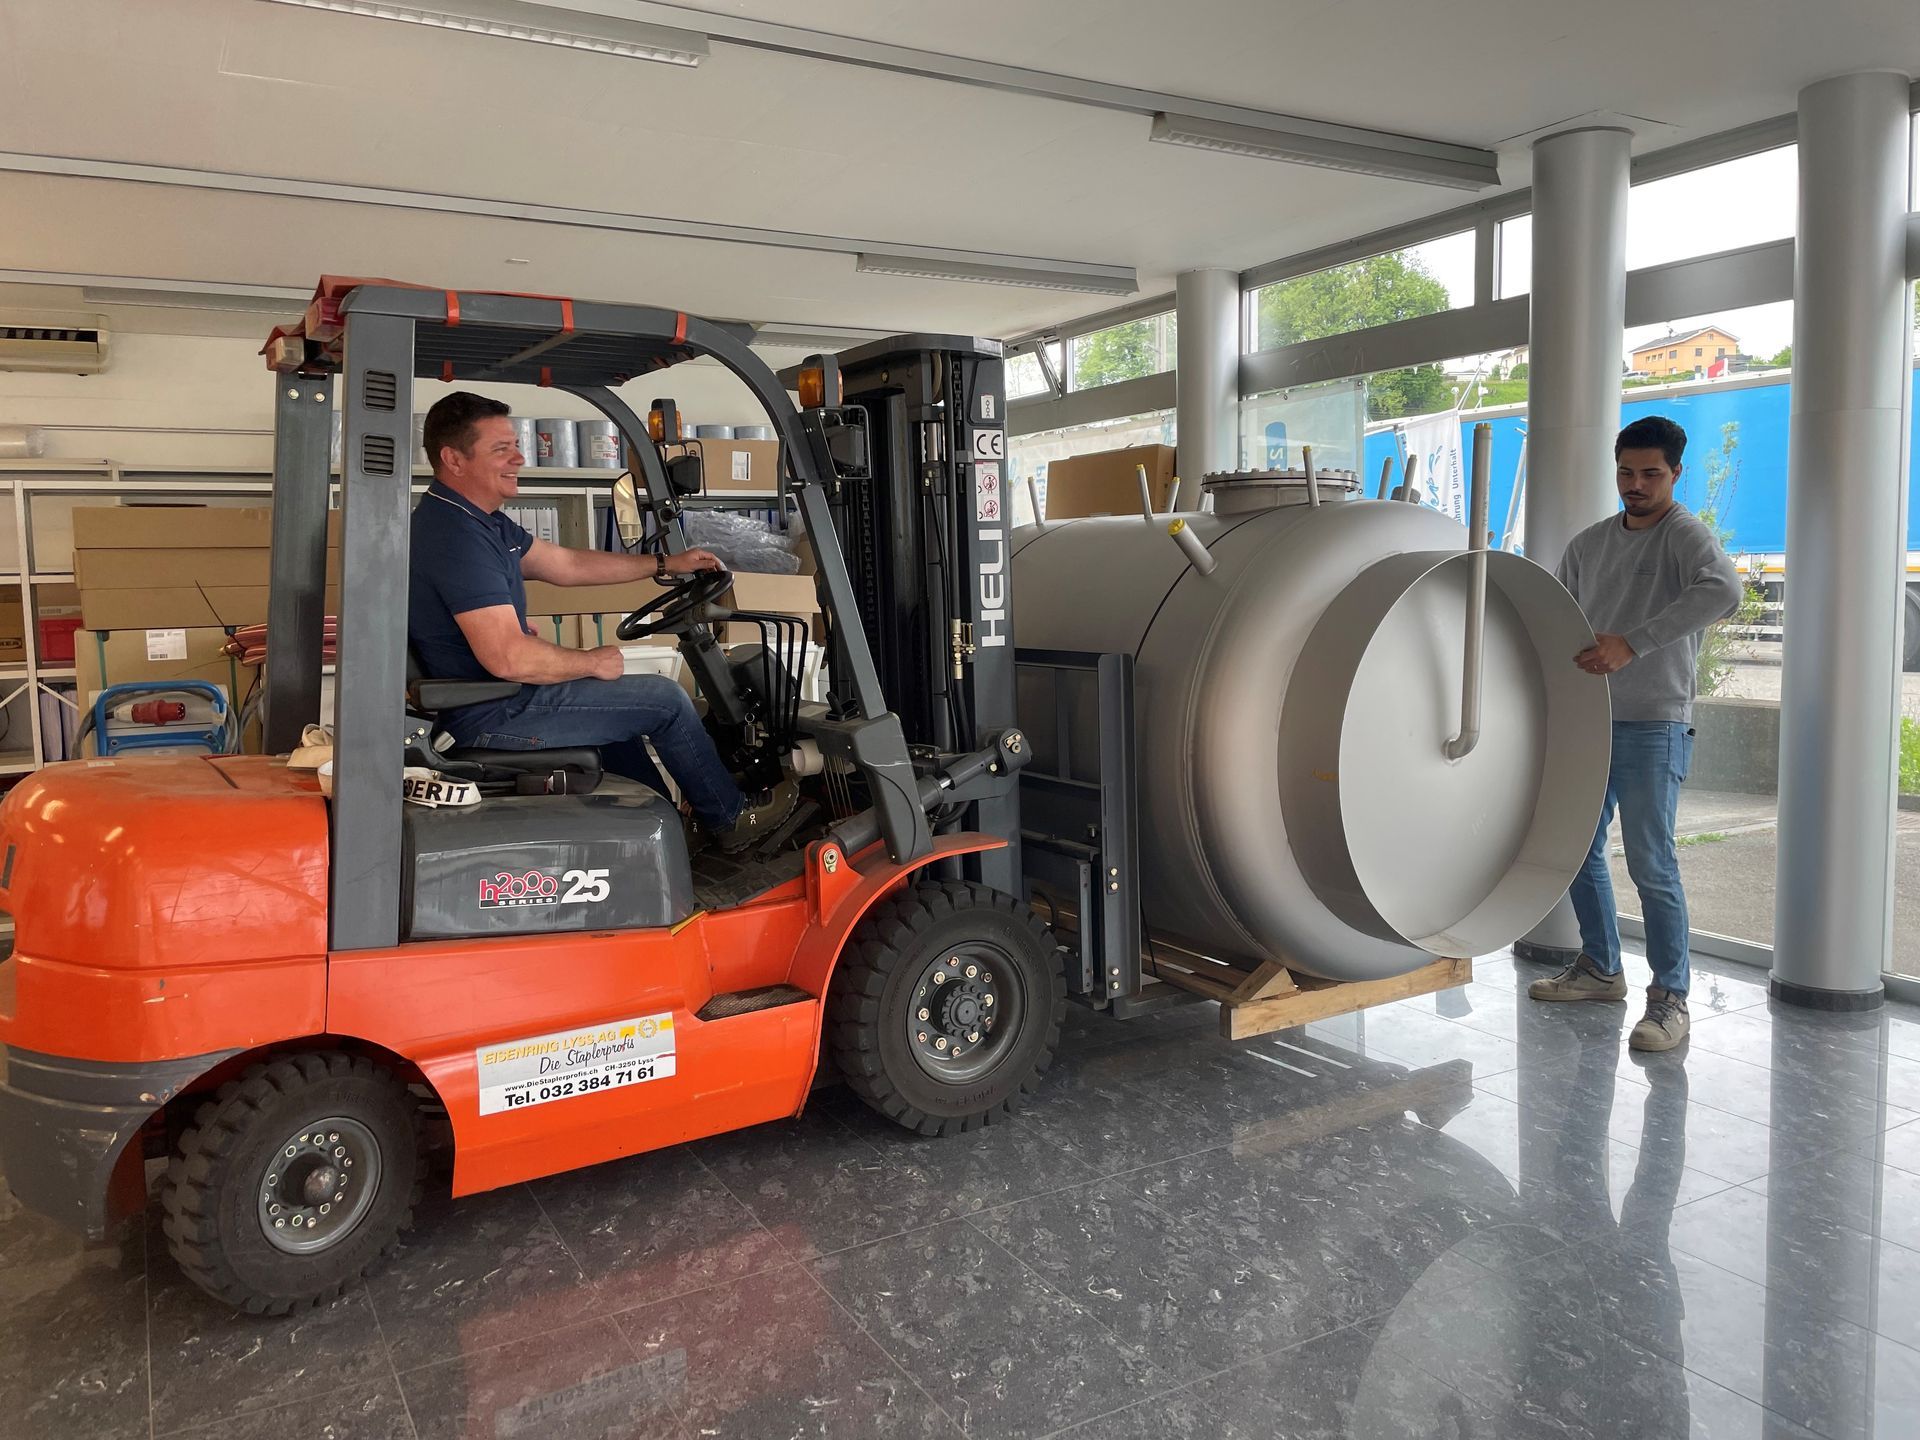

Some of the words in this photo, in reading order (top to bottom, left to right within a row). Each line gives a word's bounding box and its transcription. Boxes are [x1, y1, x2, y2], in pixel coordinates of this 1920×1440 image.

[976, 433, 1001, 455] CE
[1450, 448, 1458, 489] Unterhalt
[978, 529, 1005, 647] HELI
[479, 871, 558, 903] h2000
[561, 869, 610, 904] 25
[498, 897, 554, 906] SERIES
[482, 1041, 559, 1065] EISENRING
[562, 1034, 595, 1049] LYSS
[597, 1031, 617, 1044] AG
[539, 1056, 561, 1074] Die
[567, 1034, 635, 1066] Staplerprofis
[504, 1068, 599, 1092] www.DieStaplerprofis.ch
[605, 1061, 637, 1072] CH-3250
[638, 1057, 654, 1066] Lyss
[505, 1091, 536, 1107] Tel.
[540, 1083, 574, 1100] 032
[578, 1075, 611, 1092] 384
[616, 1069, 633, 1084] 71
[637, 1065, 655, 1080] 61
